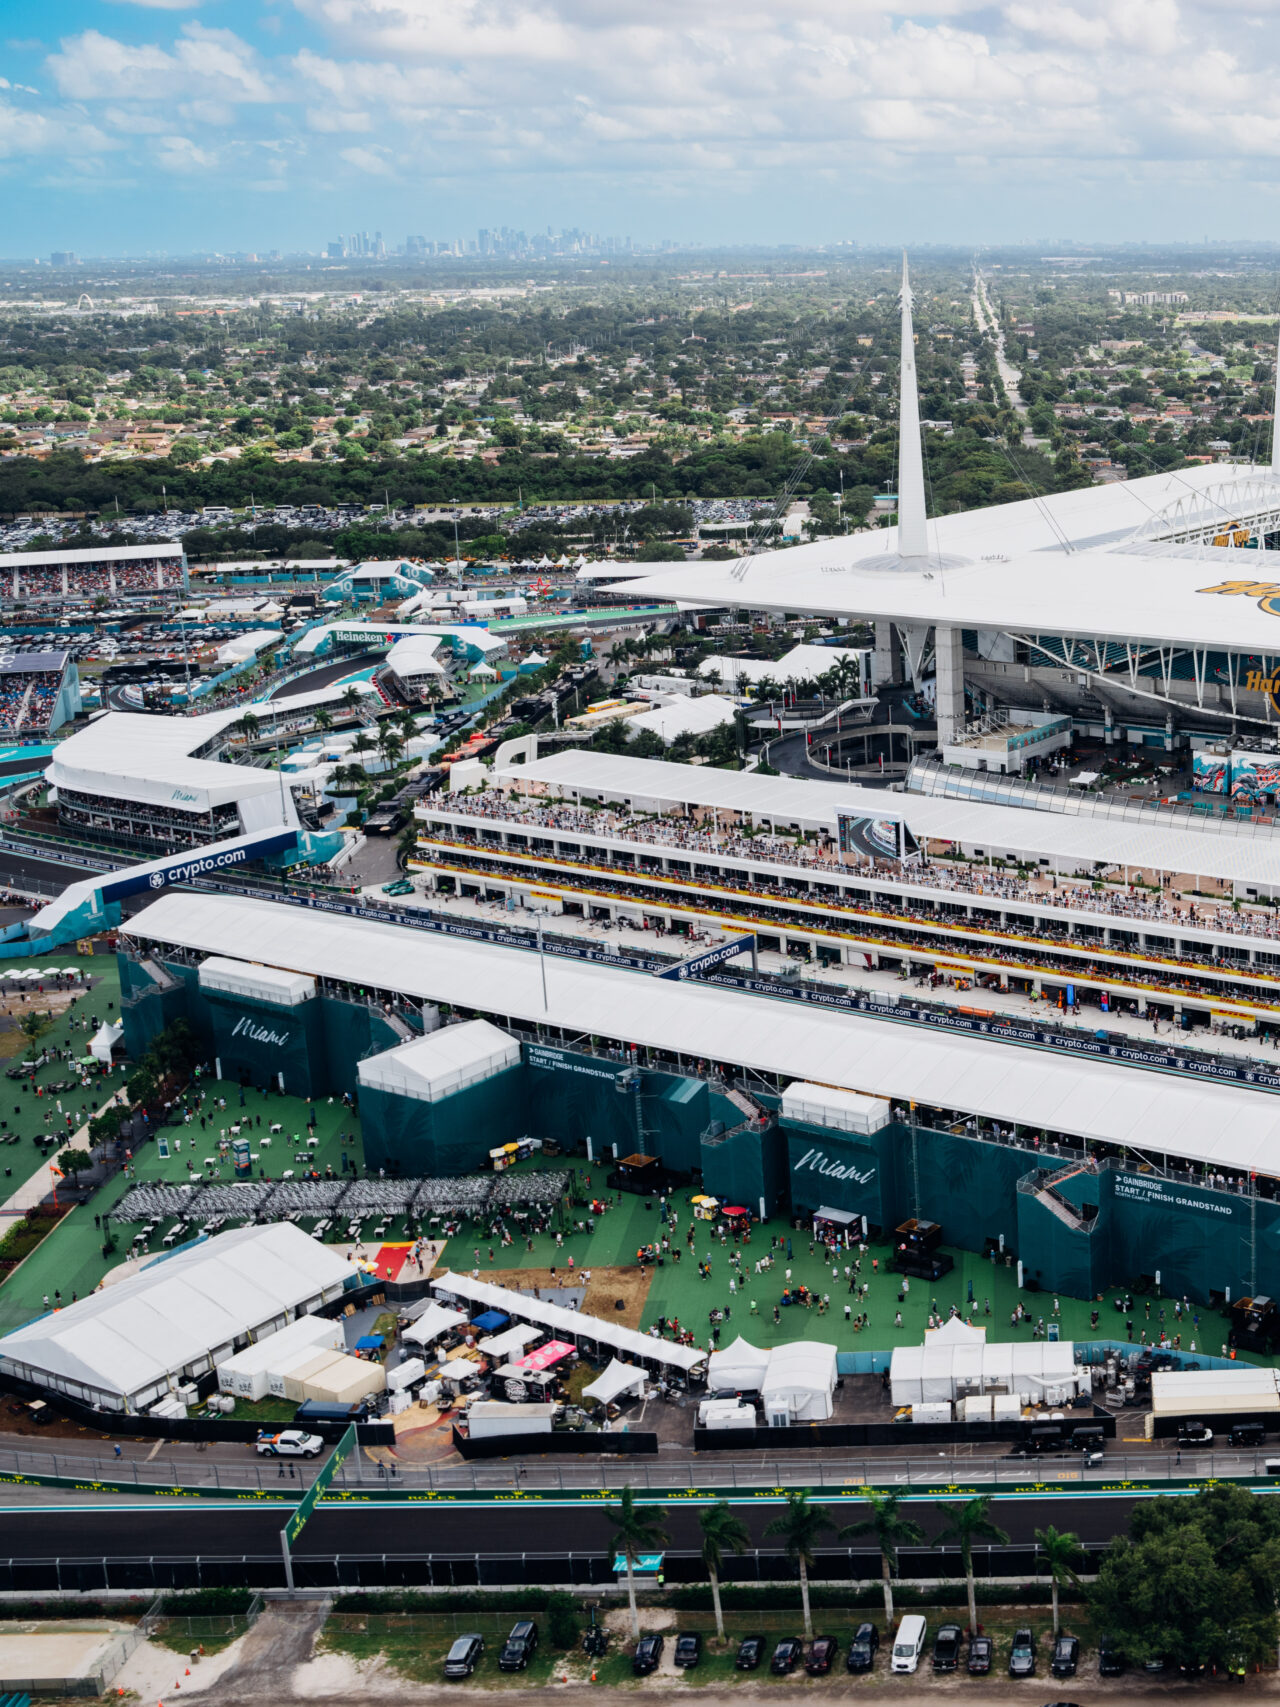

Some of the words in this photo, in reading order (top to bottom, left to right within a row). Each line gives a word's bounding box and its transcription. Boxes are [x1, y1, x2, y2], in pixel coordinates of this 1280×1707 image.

[393, 579, 409, 589] 10
[336, 632, 383, 643] Heineken
[458, 636, 468, 651] 3
[171, 788, 199, 802] Miami
[168, 849, 246, 881] crypto.com
[316, 901, 346, 912] crypto.com
[360, 909, 390, 920] crypto.com
[404, 917, 436, 928] crypto.com
[450, 926, 482, 937] crypto.com
[497, 934, 530, 946] crypto.com
[546, 944, 580, 956] crypto.com
[595, 953, 631, 966] crypto.com
[690, 945, 740, 971] crypto.com
[754, 982, 794, 995] crypto.com
[811, 992, 851, 1006] crypto.com
[870, 1002, 910, 1016] crypto.com
[930, 1014, 972, 1028] crypto.com
[231, 1016, 290, 1047] Miami
[992, 1025, 1035, 1040] crypto.com
[1056, 1037, 1100, 1052] crypto.com
[1121, 1048, 1168, 1064] crypto.com
[529, 1056, 547, 1066] START
[552, 1060, 572, 1070] FINISH
[574, 1065, 615, 1080] GRANDSTAND
[1189, 1062, 1237, 1077] crypto.com
[794, 1148, 876, 1186] Miami
[1123, 1176, 1162, 1192] GAINBRIDGE
[1115, 1184, 1140, 1196] START
[1148, 1191, 1174, 1203] FINISH
[1176, 1197, 1232, 1215] GRANDSTAND
[1132, 1194, 1150, 1202] CAMPUS
[75, 1484, 119, 1492] ROLEX
